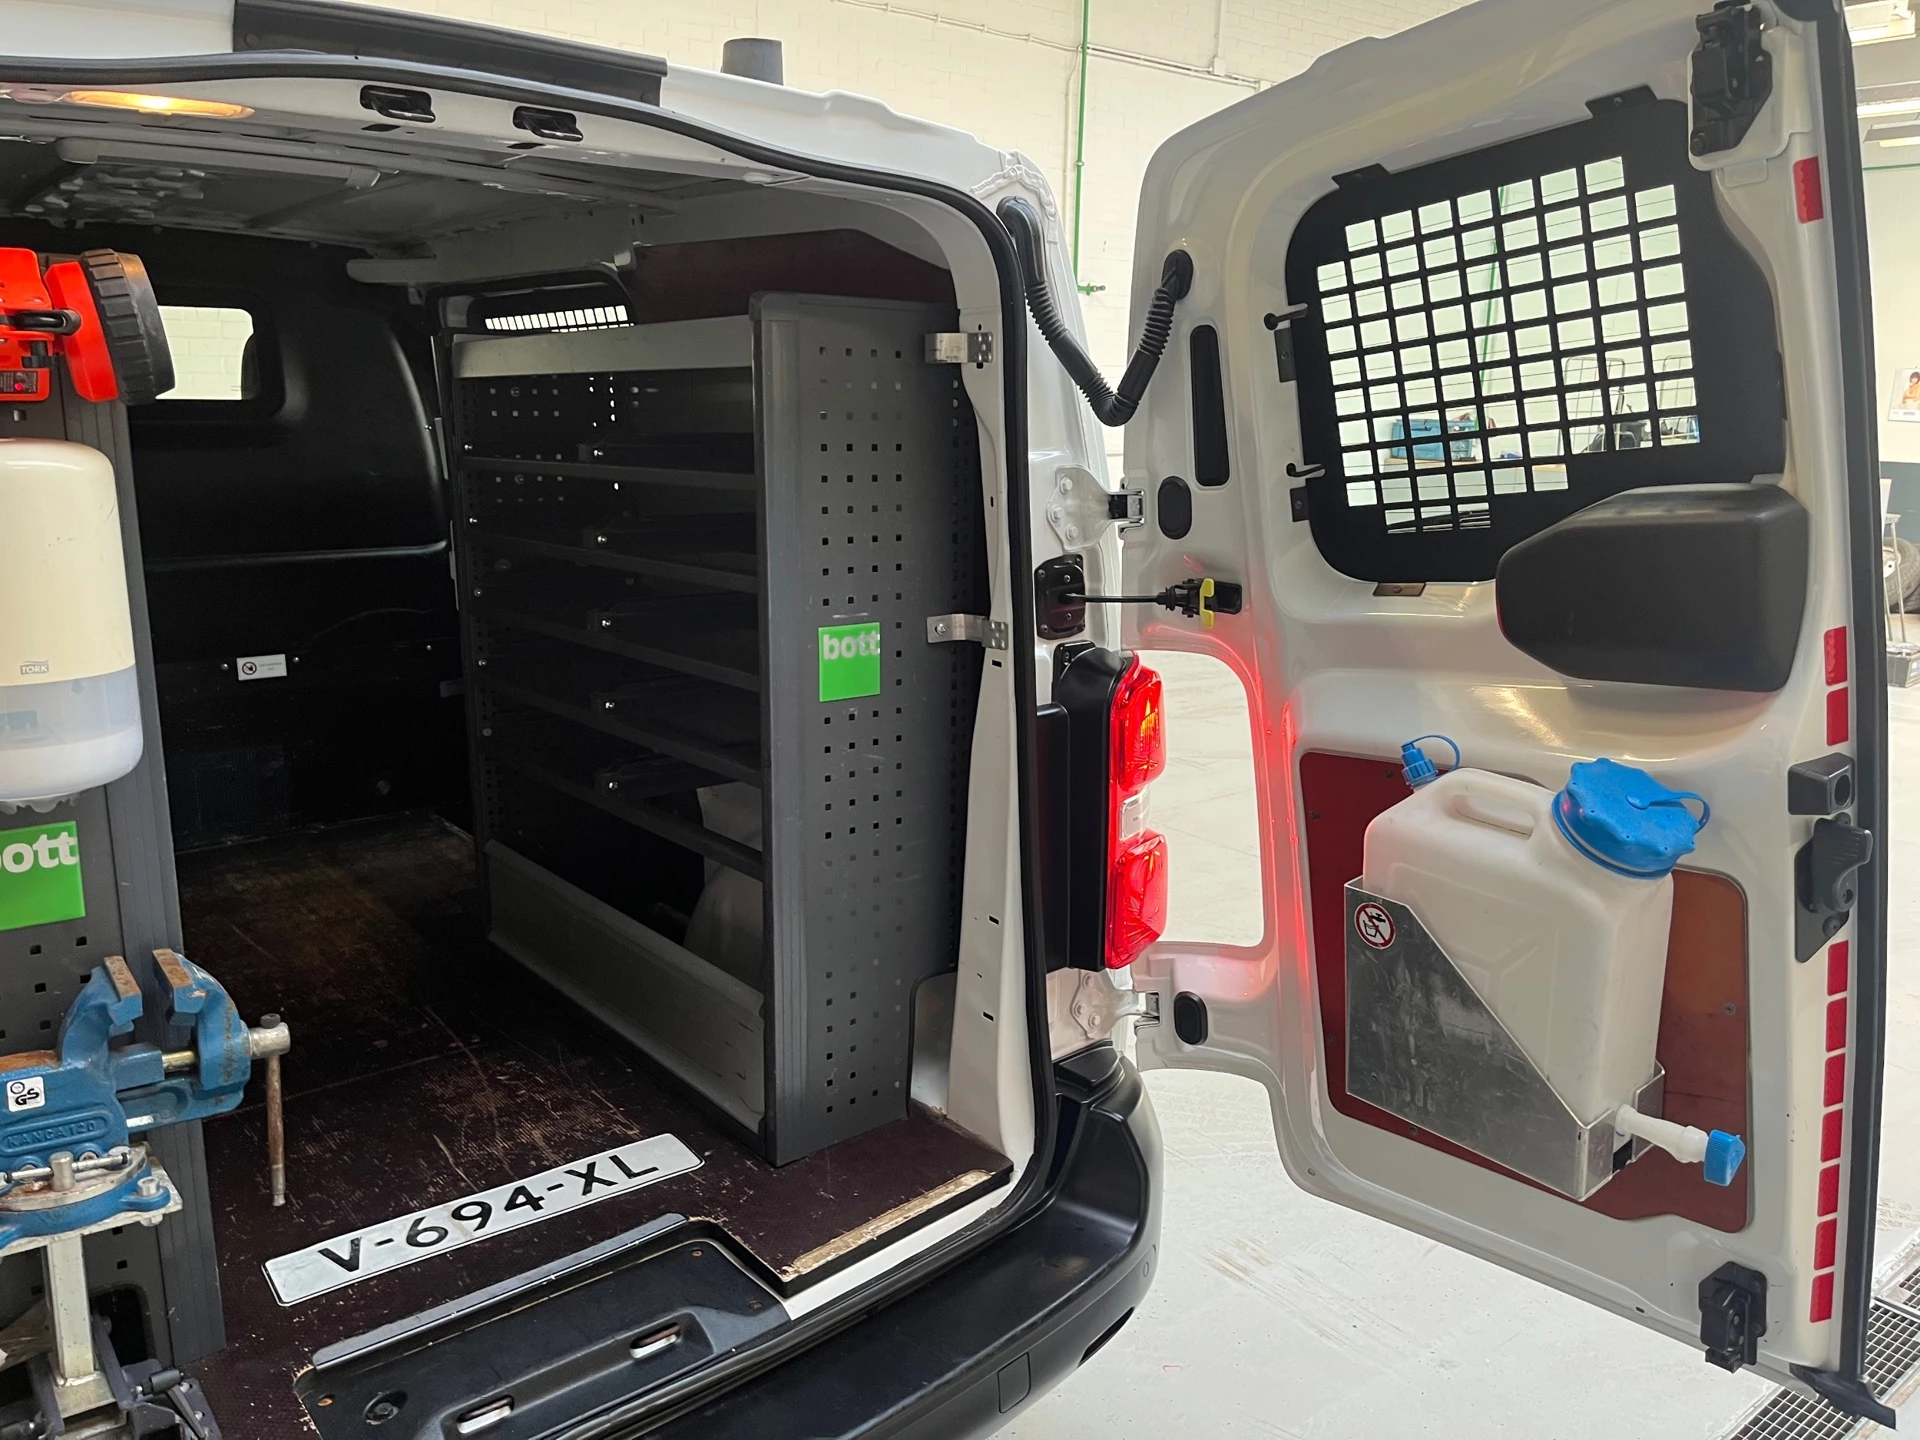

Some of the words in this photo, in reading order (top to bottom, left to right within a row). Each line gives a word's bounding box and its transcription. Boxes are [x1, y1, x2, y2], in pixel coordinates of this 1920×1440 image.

[823, 630, 880, 660] bott
[21, 664, 48, 674] TORK
[0, 832, 79, 873] ott
[15, 1087, 40, 1106] GS
[318, 1153, 659, 1273] V-694-XL
